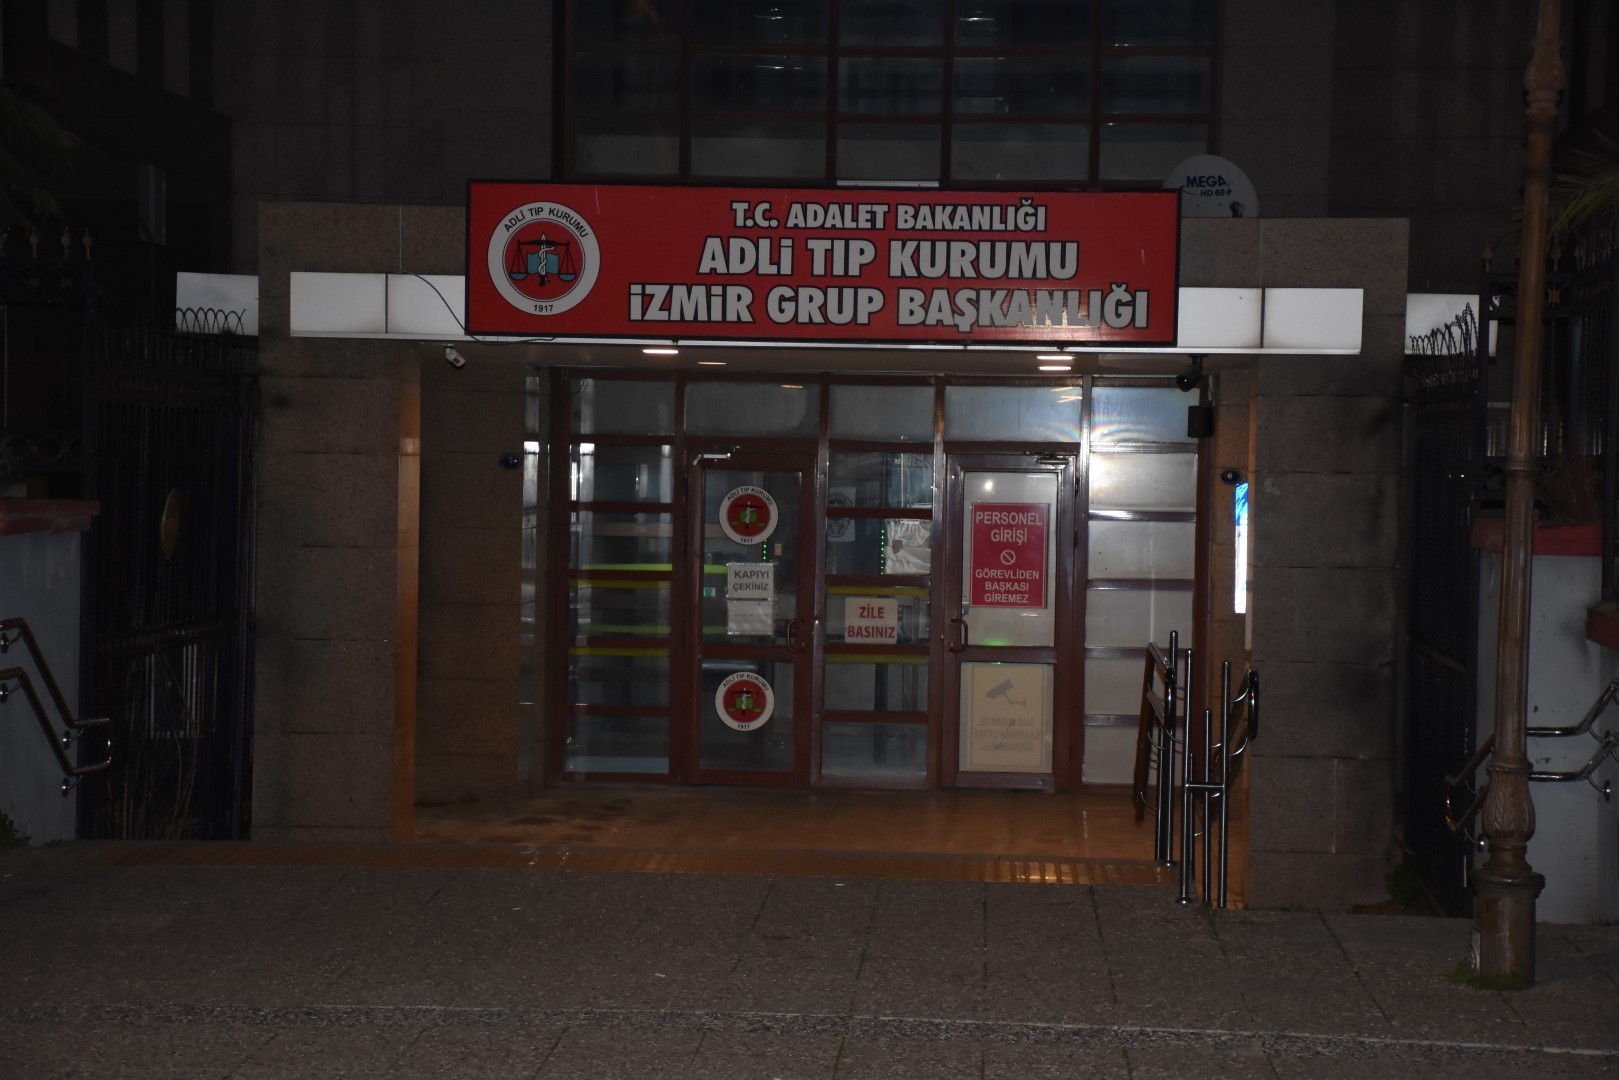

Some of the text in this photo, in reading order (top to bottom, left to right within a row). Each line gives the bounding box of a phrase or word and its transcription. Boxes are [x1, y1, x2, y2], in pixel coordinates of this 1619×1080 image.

[1200, 189, 1213, 197] HD
[731, 198, 1047, 231] T.C. ADALET BAKANLIĞI
[504, 206, 589, 238] ADLİ TIP KURUMU
[805, 238, 877, 277] TIP
[888, 239, 1079, 280] KURUMU
[534, 304, 554, 312] 1917
[766, 285, 885, 325] GRUP
[897, 282, 1150, 333] BAŞKANLIĞI
[975, 511, 1043, 526] PERSONEL
[990, 526, 1028, 546] GİRİŞİ
[734, 570, 769, 579] KAPIYI
[975, 567, 1040, 579] GÖREVLİDEN
[732, 580, 769, 592] ÇEKİNİZ
[985, 581, 1029, 593] BAŞKASI
[984, 591, 1029, 603] GİREMEZ
[859, 604, 884, 619] ZİLE
[847, 625, 895, 639] BASINIZ
